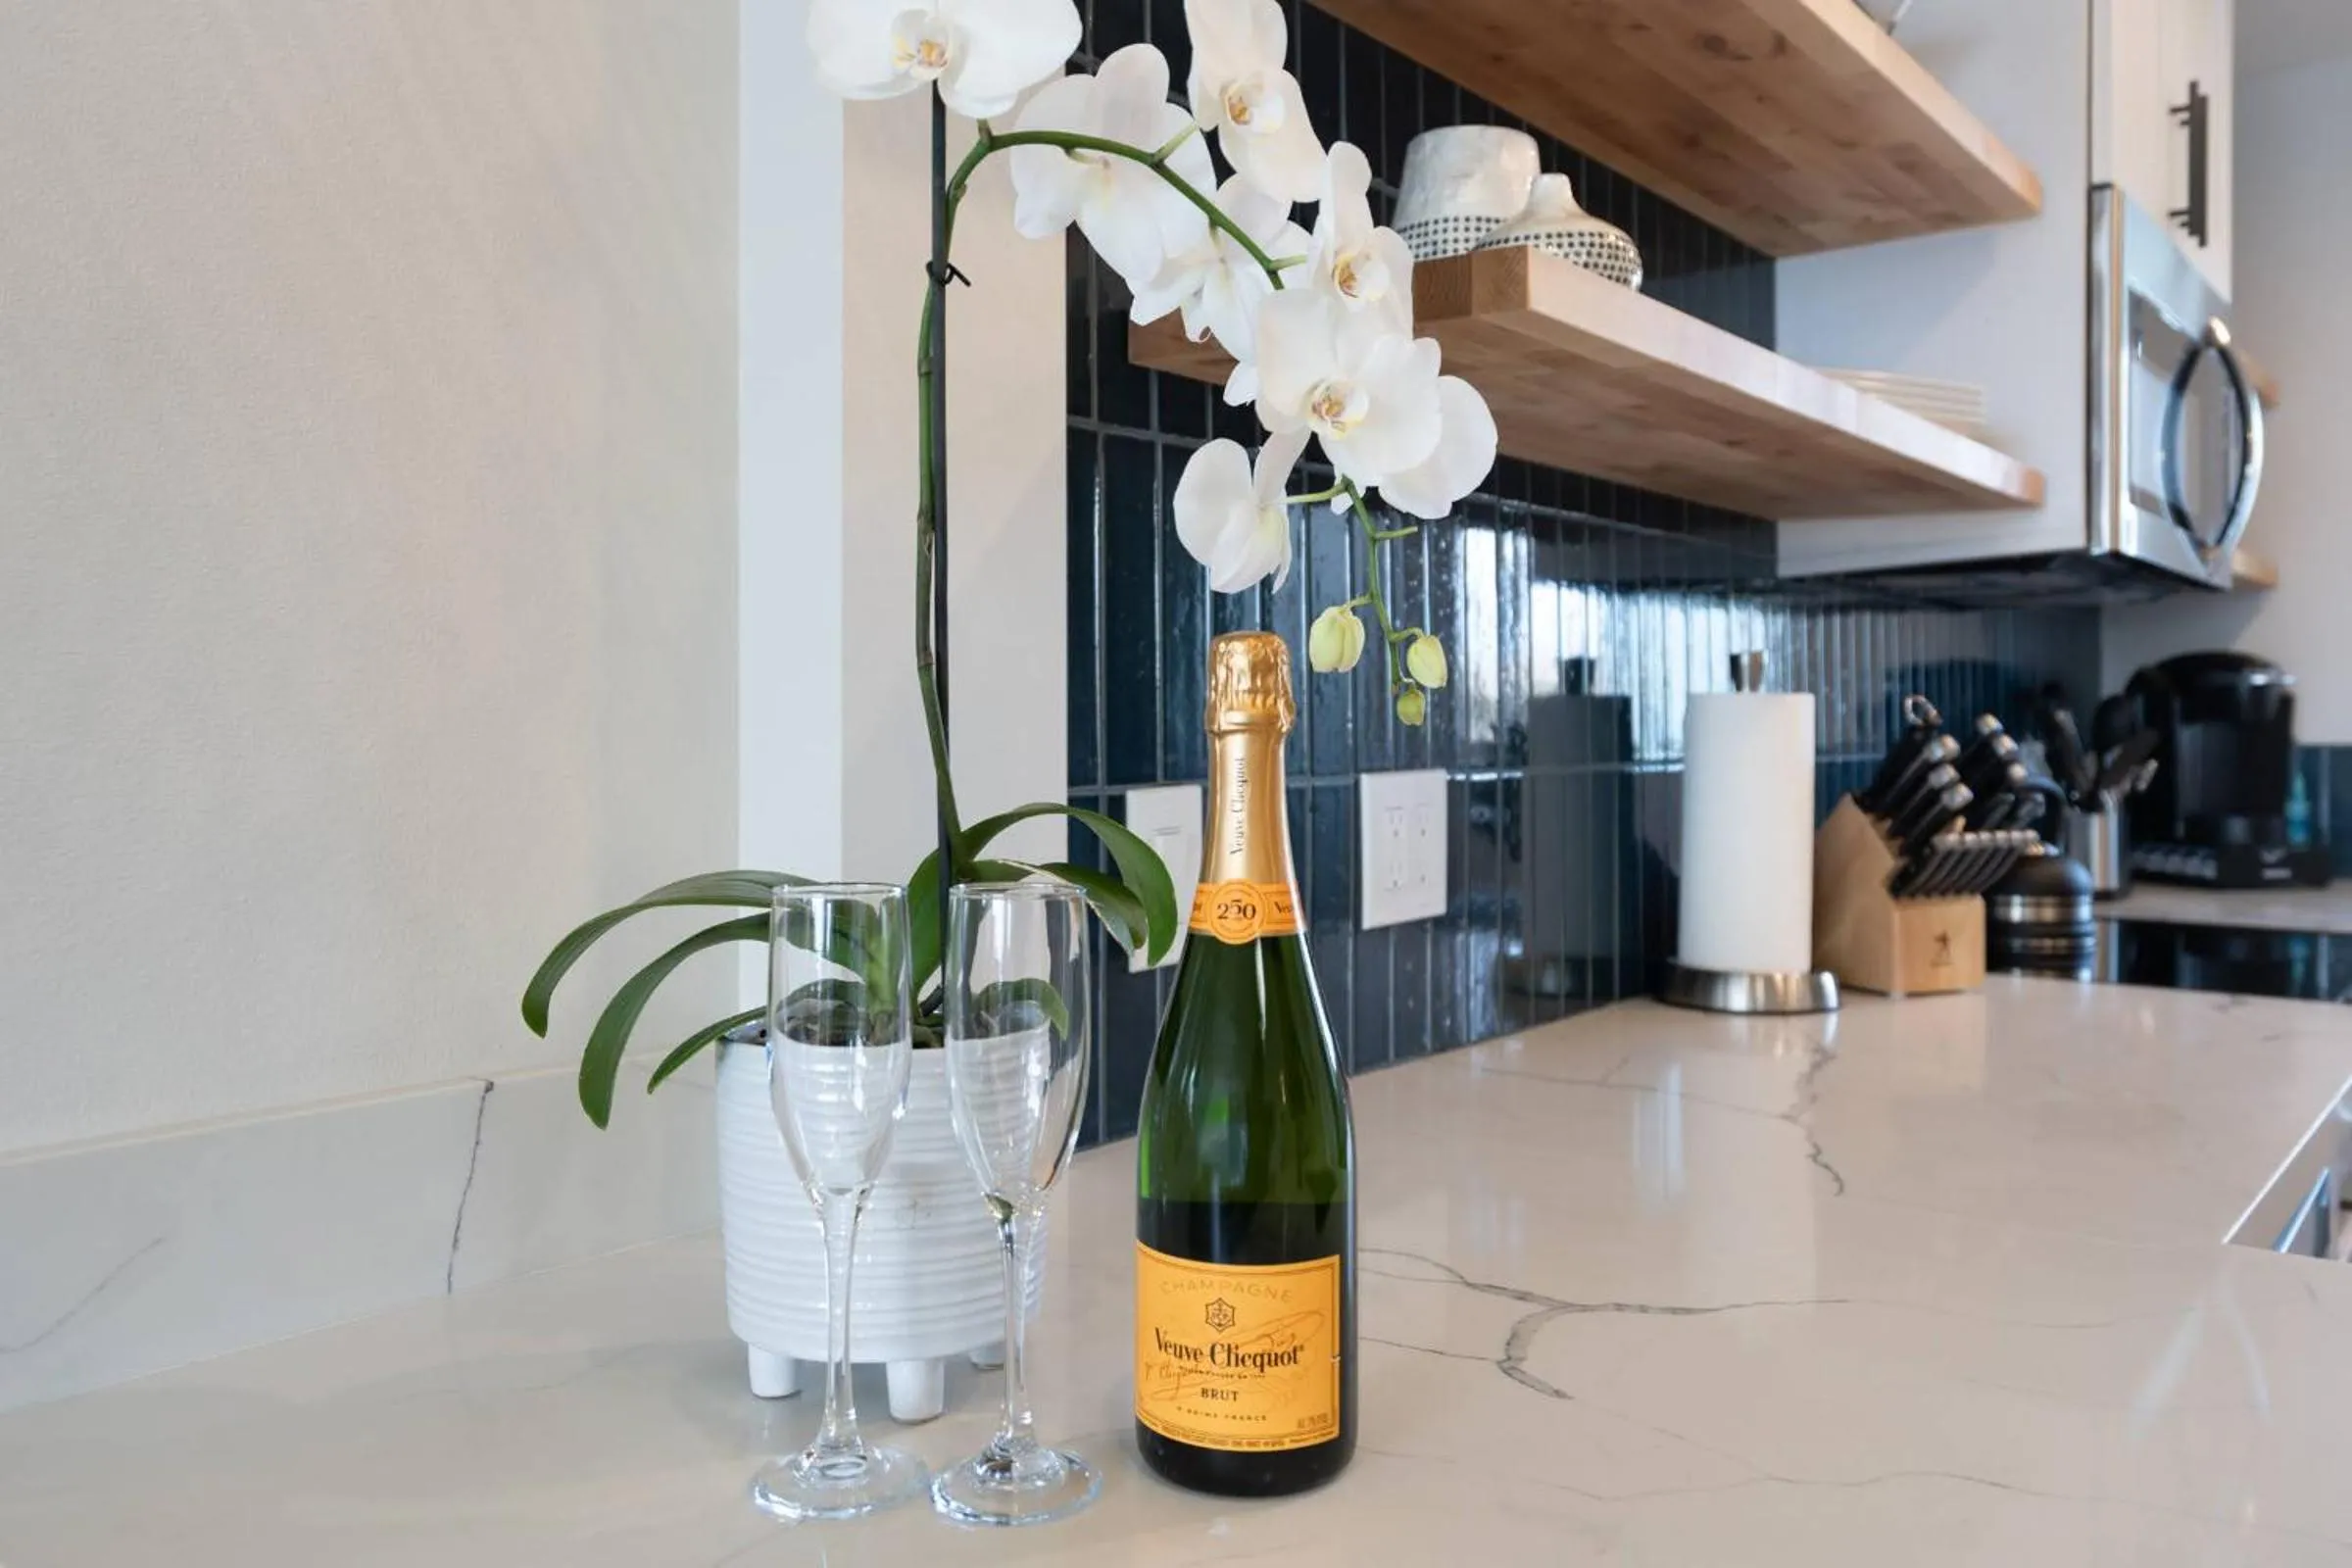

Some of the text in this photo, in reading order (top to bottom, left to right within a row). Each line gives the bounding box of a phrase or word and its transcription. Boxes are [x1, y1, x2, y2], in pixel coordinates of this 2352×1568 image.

[1216, 899, 1257, 920] 250
[1160, 1279, 1294, 1302] CHAMPAGNE
[1154, 1326, 1299, 1373] Veuve Clicquot
[1200, 1387, 1240, 1402] BRUT
